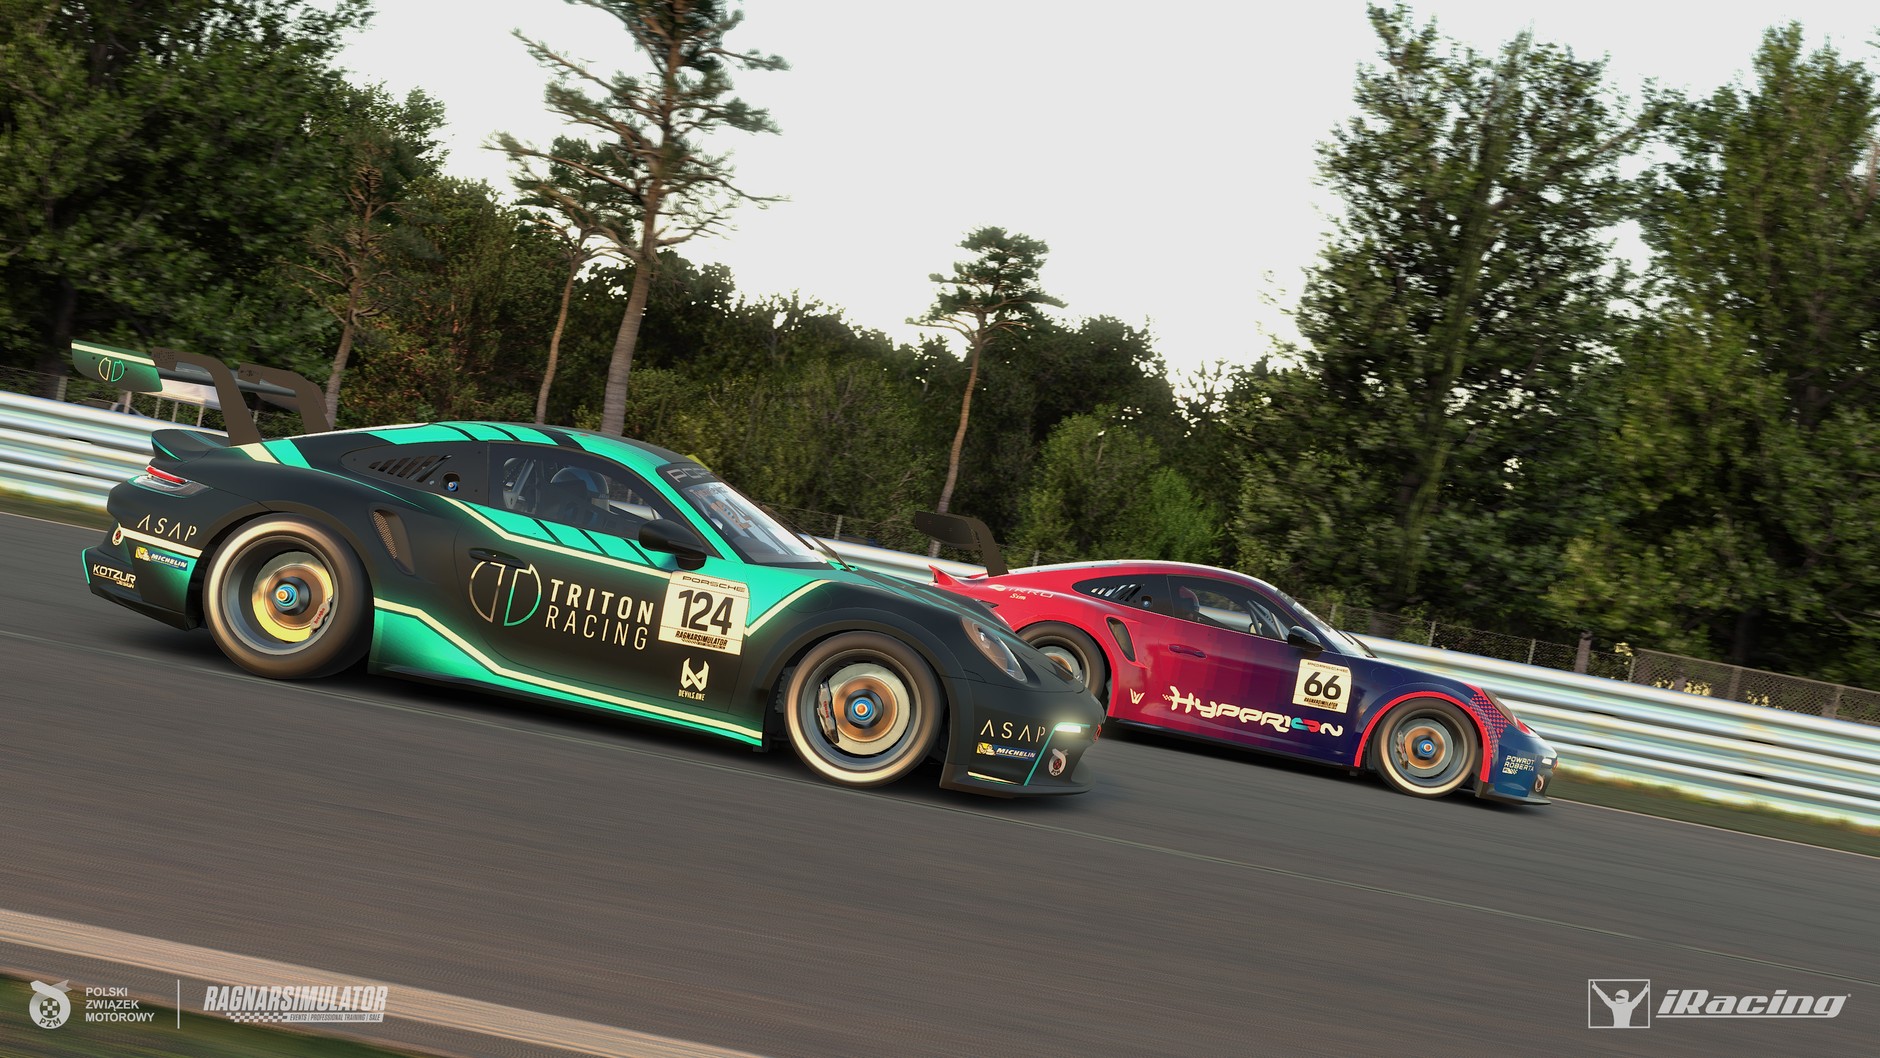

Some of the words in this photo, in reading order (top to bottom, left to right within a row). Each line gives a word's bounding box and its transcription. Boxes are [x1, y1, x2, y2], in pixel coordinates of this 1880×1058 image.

[137, 514, 197, 541] ASAP
[151, 553, 187, 568] MICHELIN
[93, 564, 136, 583] KOTZUR
[682, 575, 746, 593] PORSCHE
[550, 578, 654, 625] TRITON
[678, 589, 734, 636] 124
[545, 604, 649, 650] RACING
[675, 630, 728, 647] RAGNARSIMULATOR
[1304, 671, 1342, 700] 66
[980, 719, 1046, 743] ASAP
[996, 747, 1036, 758] MICHELIN
